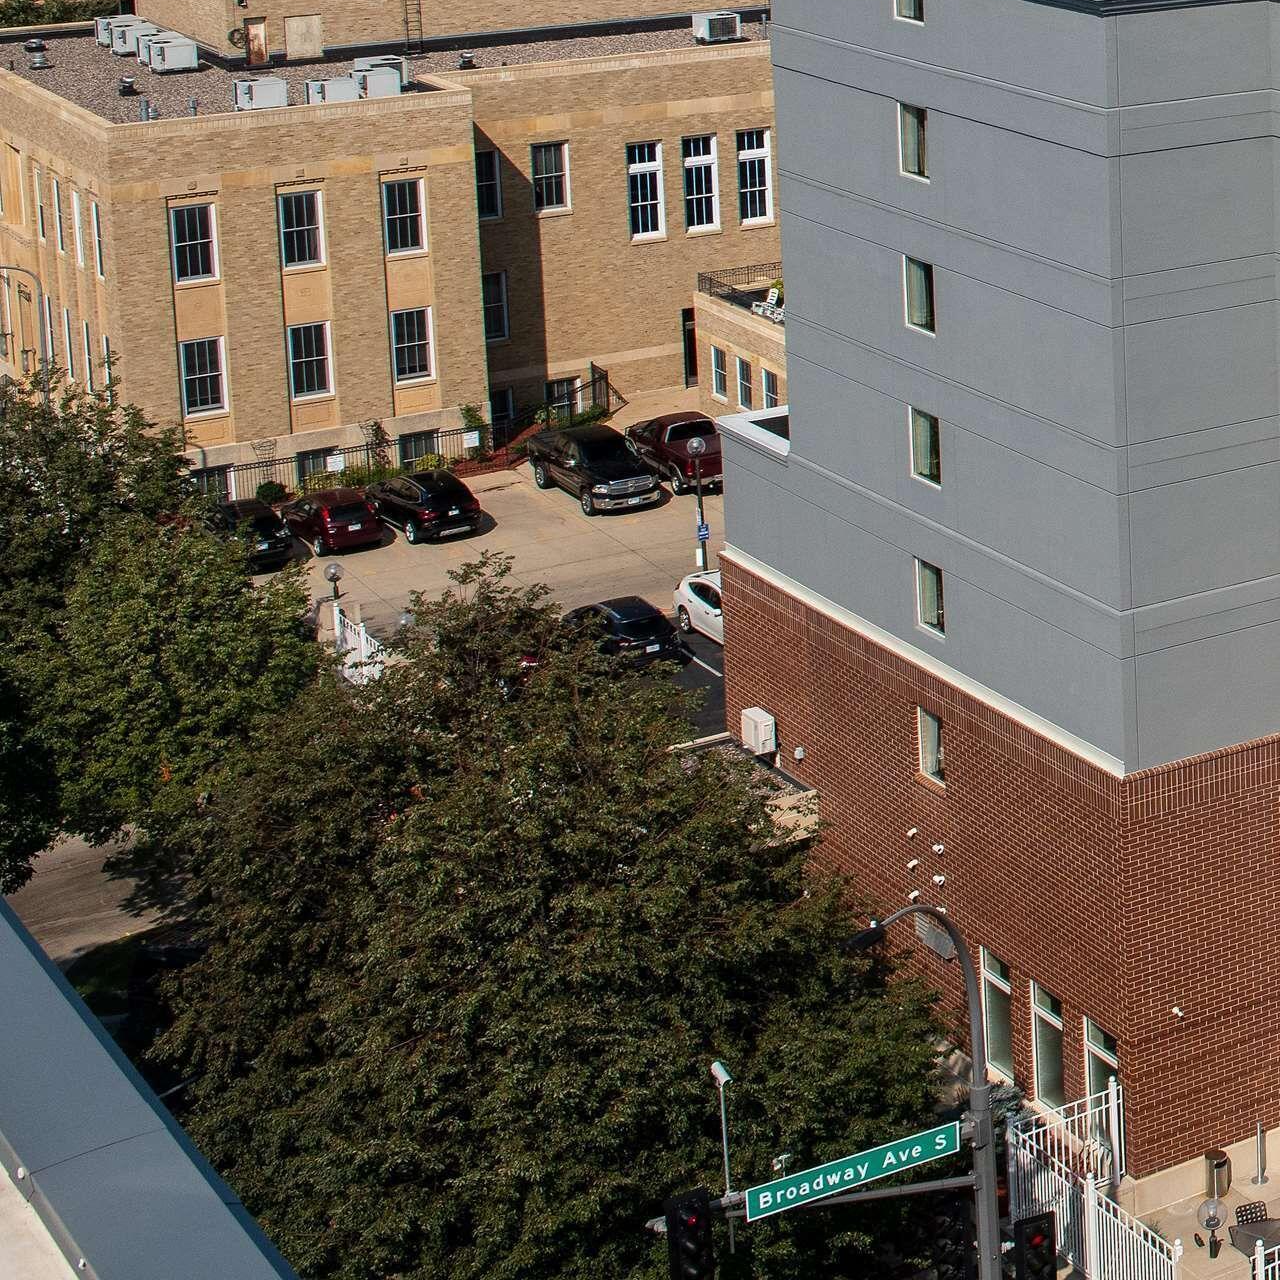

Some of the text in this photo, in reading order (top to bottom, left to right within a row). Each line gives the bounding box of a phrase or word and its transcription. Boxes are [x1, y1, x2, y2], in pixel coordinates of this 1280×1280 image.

[758, 1133, 947, 1209] Broadway Ave S
